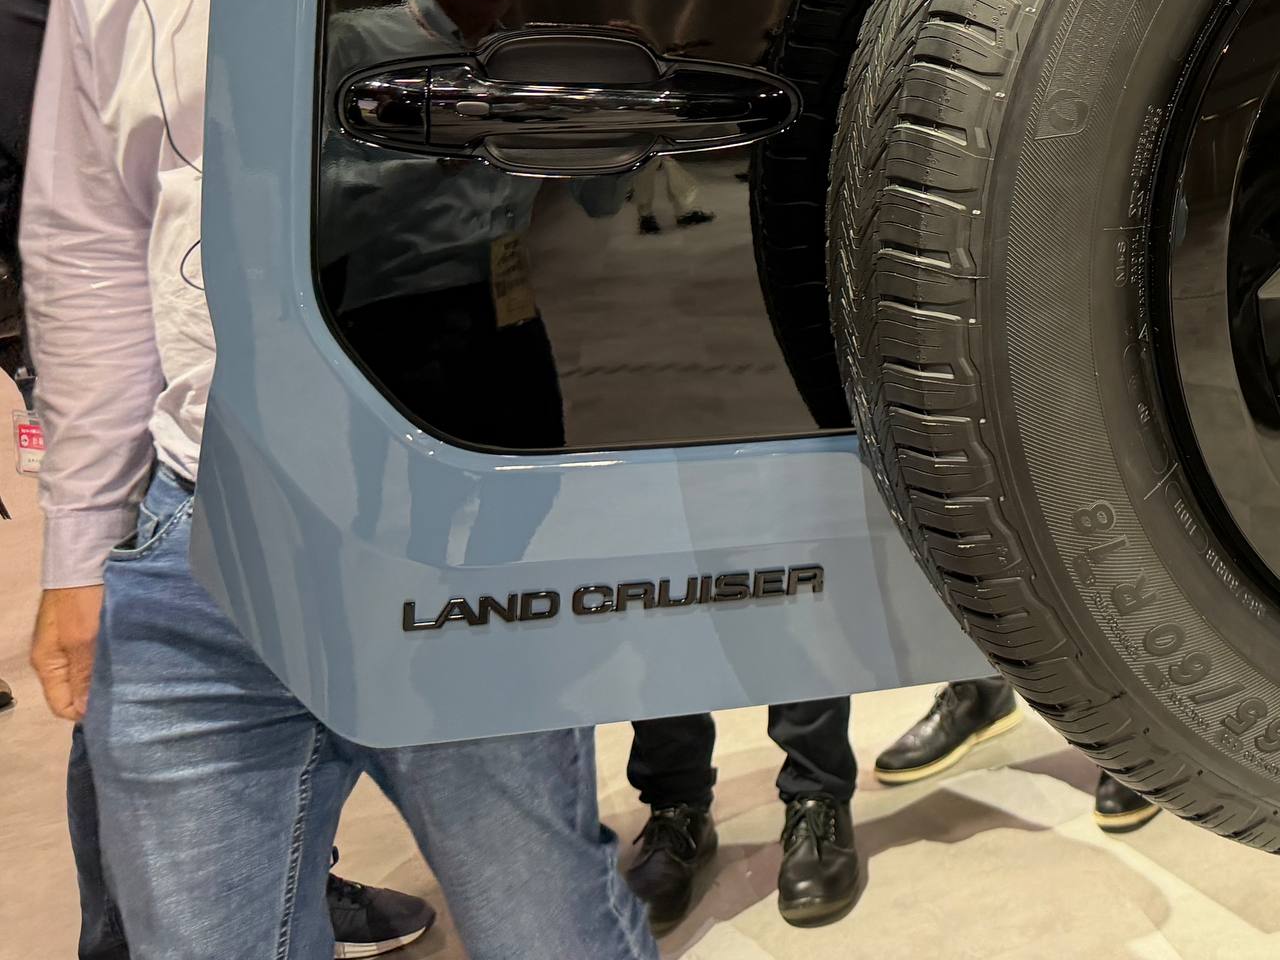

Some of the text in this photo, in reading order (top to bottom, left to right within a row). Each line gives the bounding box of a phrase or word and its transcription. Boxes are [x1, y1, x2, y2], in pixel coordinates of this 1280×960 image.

[1072, 498, 1129, 560] 18
[402, 563, 826, 634] LAND CRUISER
[1110, 568, 1161, 617] R
